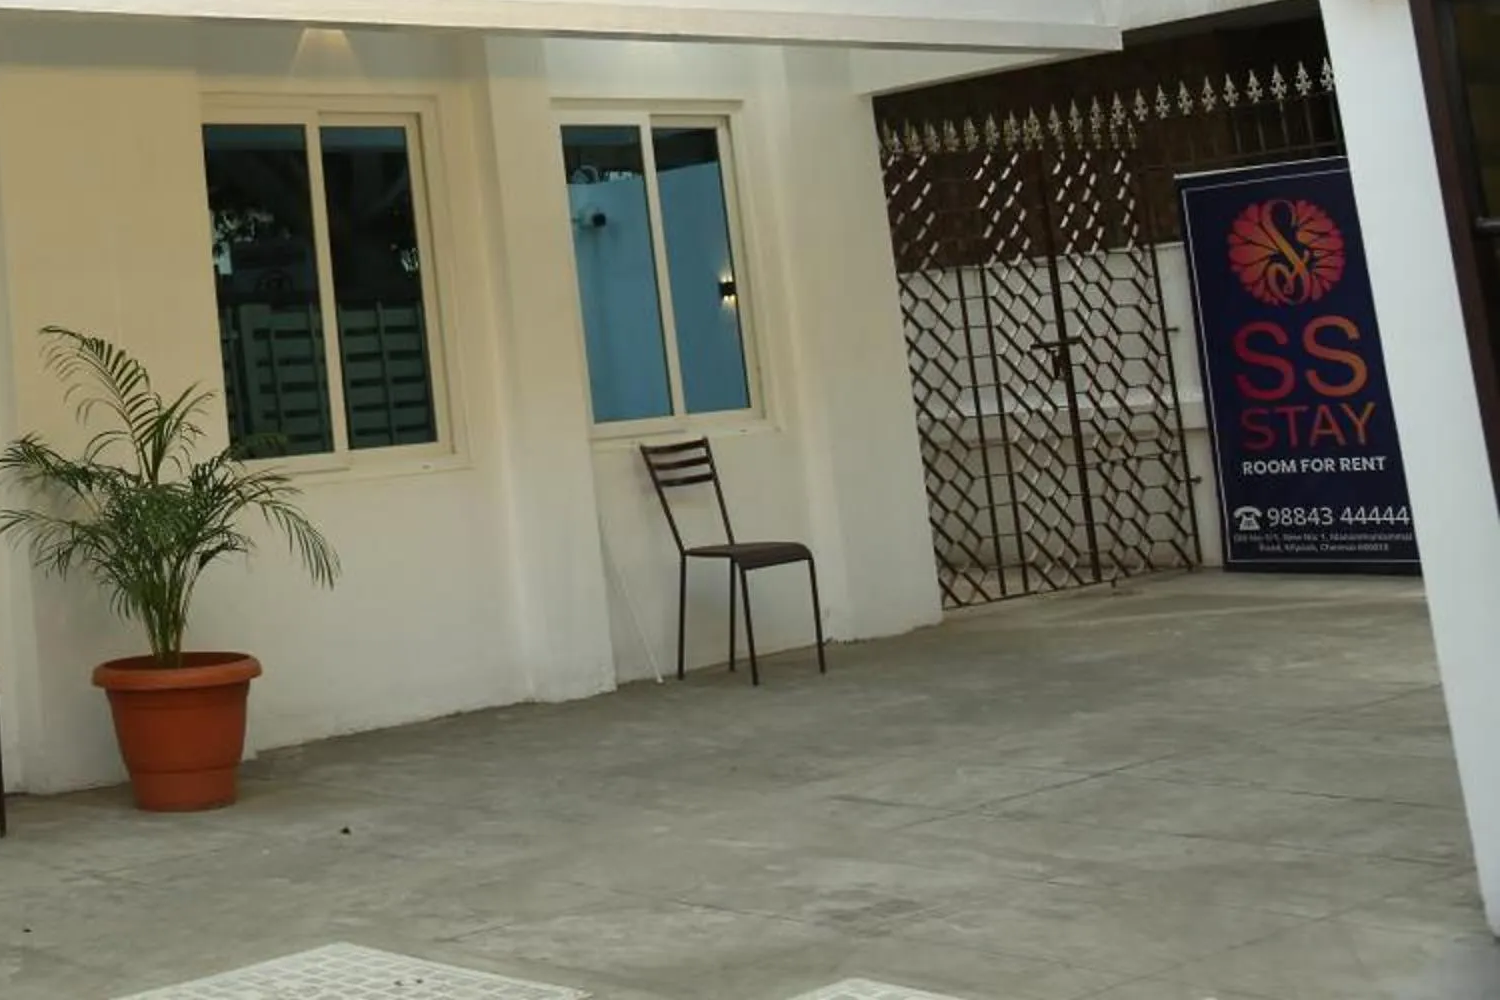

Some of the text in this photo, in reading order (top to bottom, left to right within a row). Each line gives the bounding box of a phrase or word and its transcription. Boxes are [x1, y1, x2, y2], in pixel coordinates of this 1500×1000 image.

[1233, 315, 1368, 400] SS
[1240, 401, 1376, 450] STAY
[1243, 455, 1386, 475] ROOM FOR RENT
[1267, 506, 1411, 526] 98843 44444
